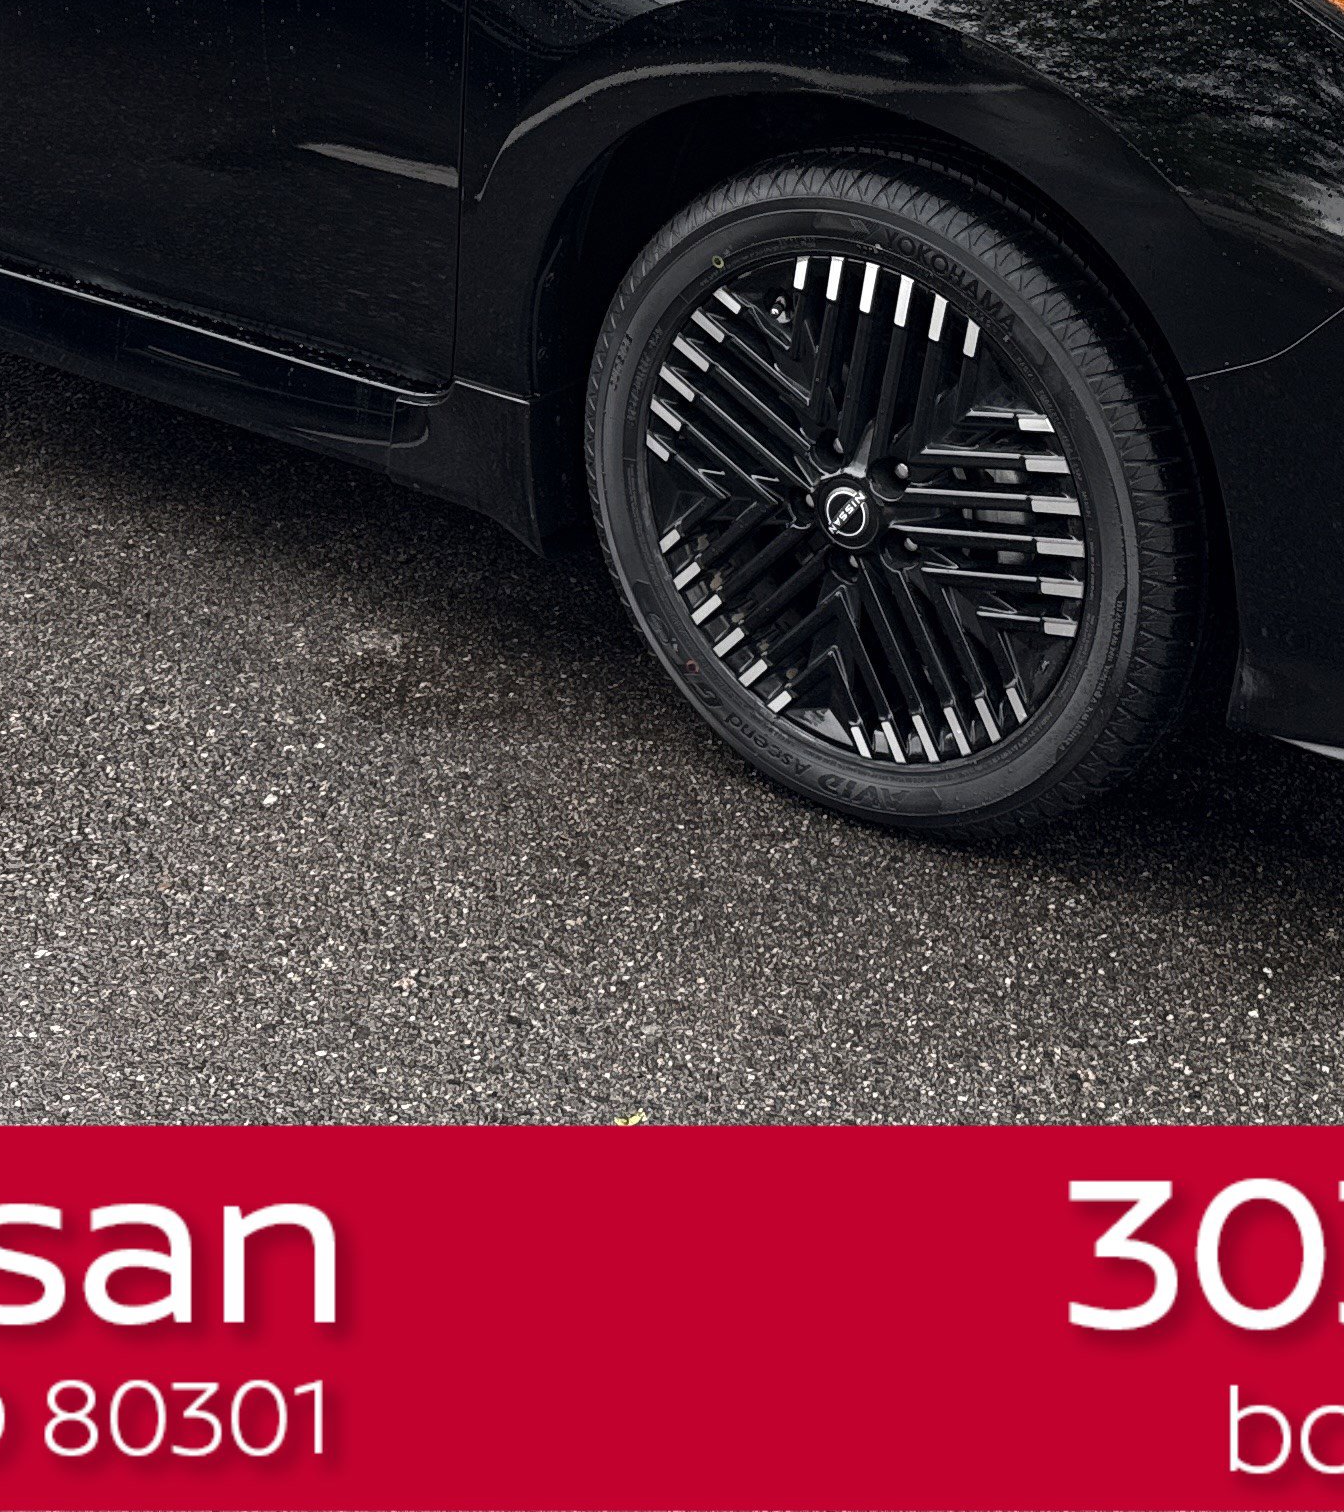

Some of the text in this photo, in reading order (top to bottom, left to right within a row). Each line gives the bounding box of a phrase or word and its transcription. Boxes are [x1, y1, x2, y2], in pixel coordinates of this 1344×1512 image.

[885, 227, 1016, 333] YOKOHAMA
[828, 490, 867, 535] NISSAN
[724, 712, 811, 778] Ascend
